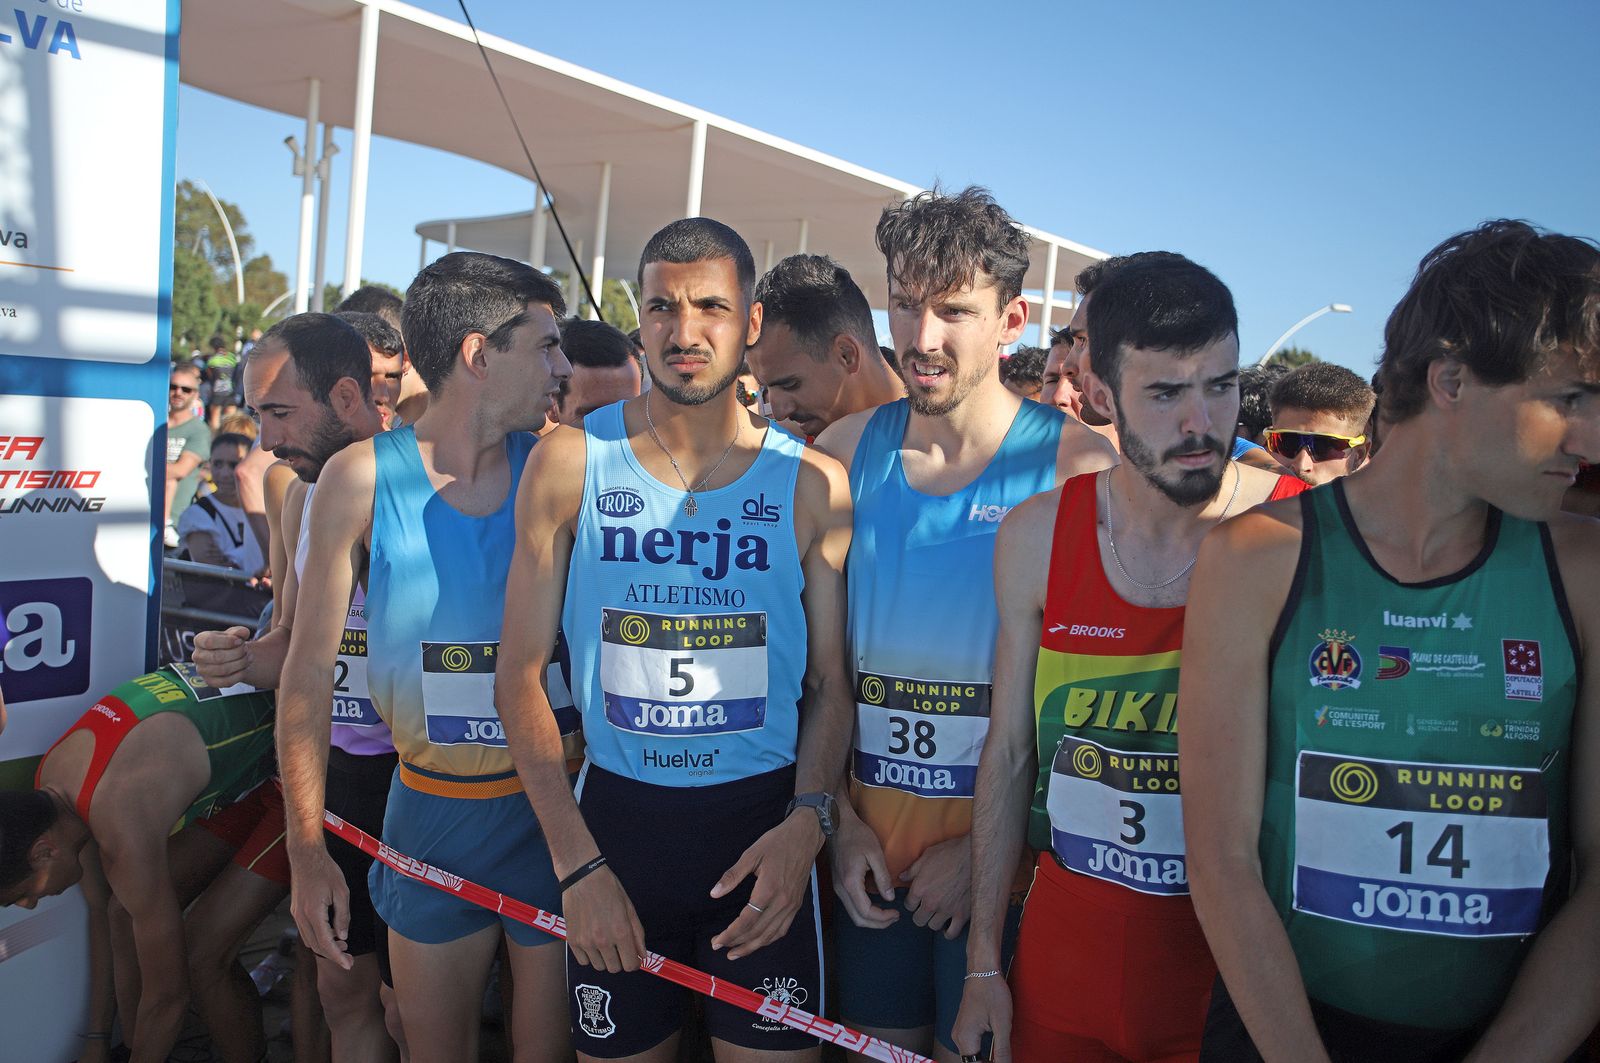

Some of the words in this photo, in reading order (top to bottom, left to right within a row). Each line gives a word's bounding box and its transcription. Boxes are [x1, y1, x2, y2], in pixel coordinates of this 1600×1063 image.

[0, 307, 17, 318] va
[0, 497, 106, 514] UNNING
[598, 492, 643, 513] TROPS
[599, 517, 771, 581] nerja
[625, 582, 746, 608] ATLETISMO
[661, 617, 747, 631] RUNNING
[1383, 610, 1448, 629] luanvi
[0, 600, 76, 674] a
[683, 634, 734, 648] LOOP
[1069, 624, 1126, 639] BROOKS
[668, 657, 695, 697] 5
[895, 680, 976, 698] RUNNING
[634, 702, 728, 728] Joma
[913, 698, 961, 713] LOOP
[1328, 711, 1380, 721] COMUNITAT
[1332, 718, 1344, 727] DE
[888, 716, 937, 760] 38
[1503, 733, 1540, 741] ALFONSO
[1504, 724, 1540, 734] TRINIDAD
[643, 748, 714, 768] Huelva
[875, 759, 956, 790] Joma
[1397, 769, 1523, 790] RUNNING
[1430, 793, 1503, 812] LOOP
[1119, 799, 1146, 845] 3
[1386, 820, 1470, 880] 14
[1352, 882, 1493, 925] Joma
[582, 987, 599, 995] CLUB
[763, 976, 798, 989] CMD
